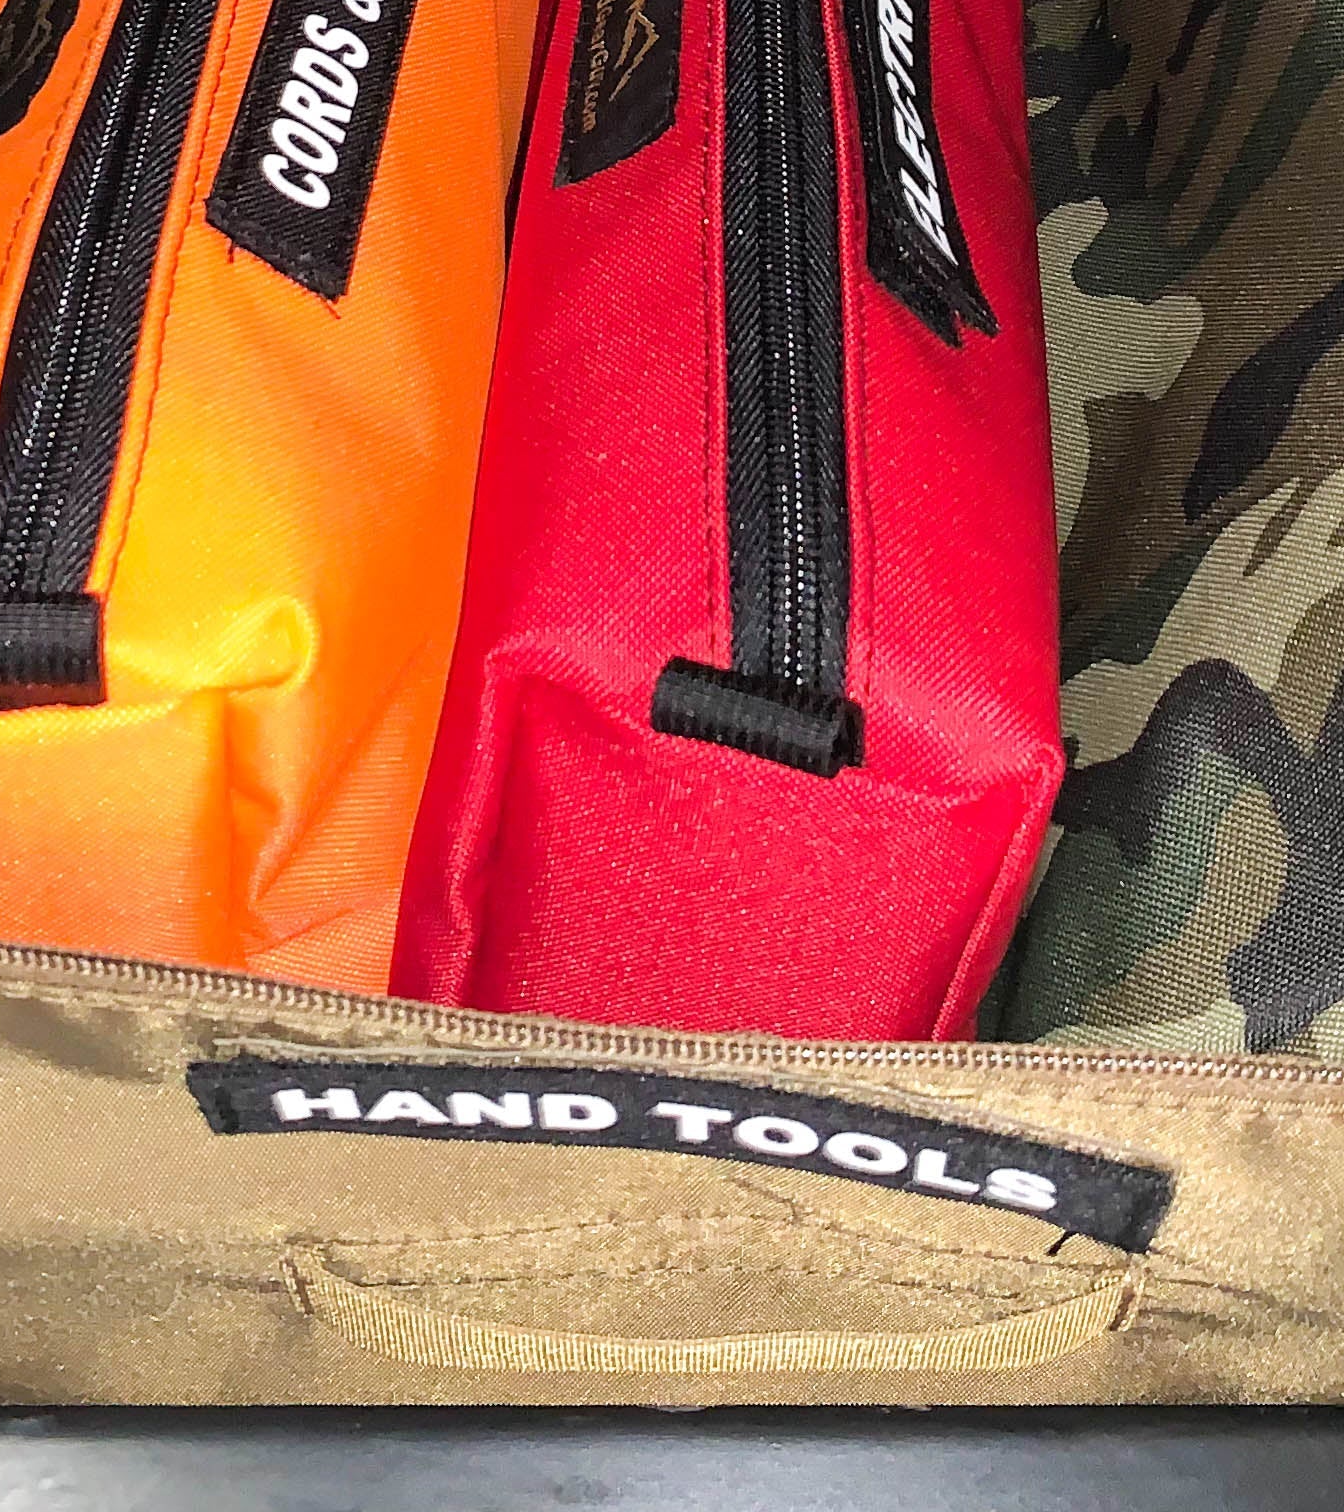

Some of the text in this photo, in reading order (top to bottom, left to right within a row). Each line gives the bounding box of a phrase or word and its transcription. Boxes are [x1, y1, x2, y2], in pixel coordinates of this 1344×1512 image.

[260, 13, 371, 211] CORDS
[270, 1087, 1058, 1212] HAND TOOLS
